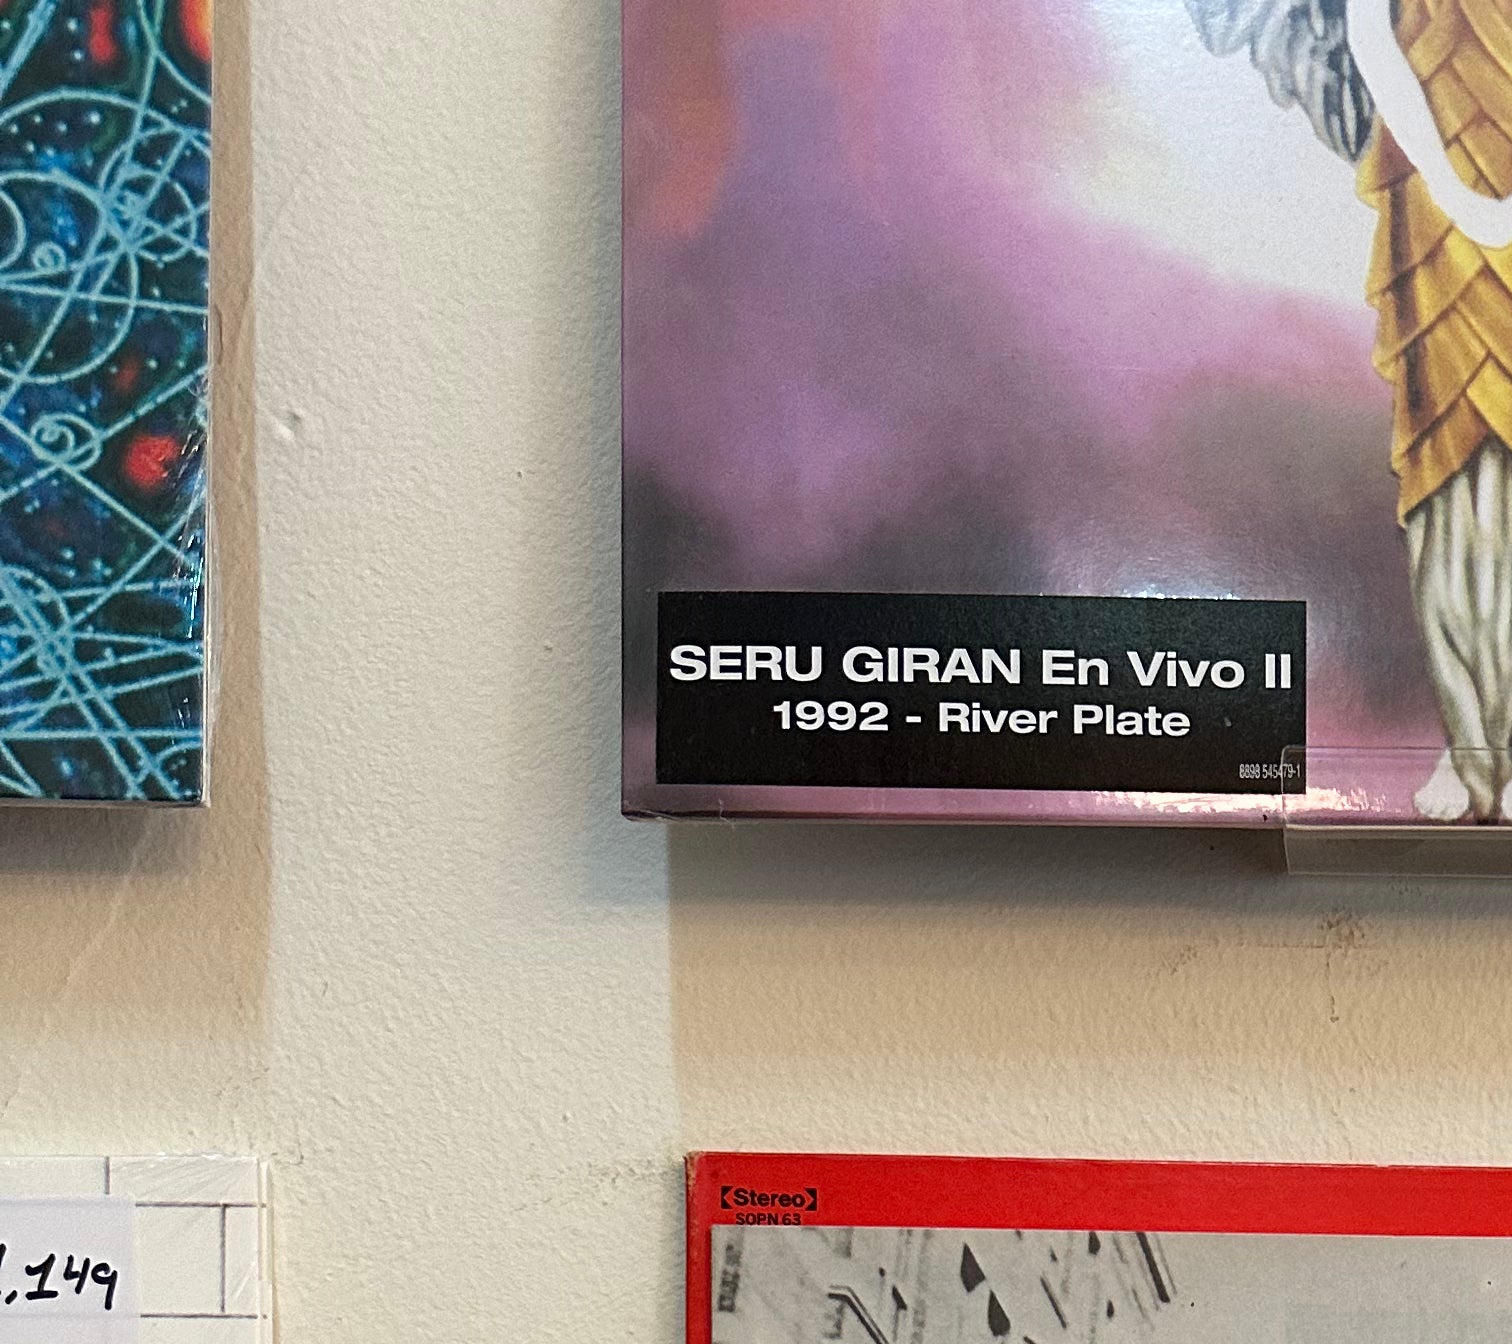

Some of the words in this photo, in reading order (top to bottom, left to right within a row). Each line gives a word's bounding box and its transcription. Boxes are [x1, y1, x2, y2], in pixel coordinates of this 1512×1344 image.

[669, 644, 822, 682] SERU
[842, 646, 1021, 684] GIRAN
[1041, 649, 1109, 687] En
[1126, 651, 1246, 689] Vivo
[1264, 653, 1292, 689] II
[773, 700, 889, 731] 1992
[938, 702, 1058, 734] River
[1073, 704, 1191, 737] Plate
[735, 1212, 779, 1226] SOPN
[781, 1212, 802, 1226] 63
